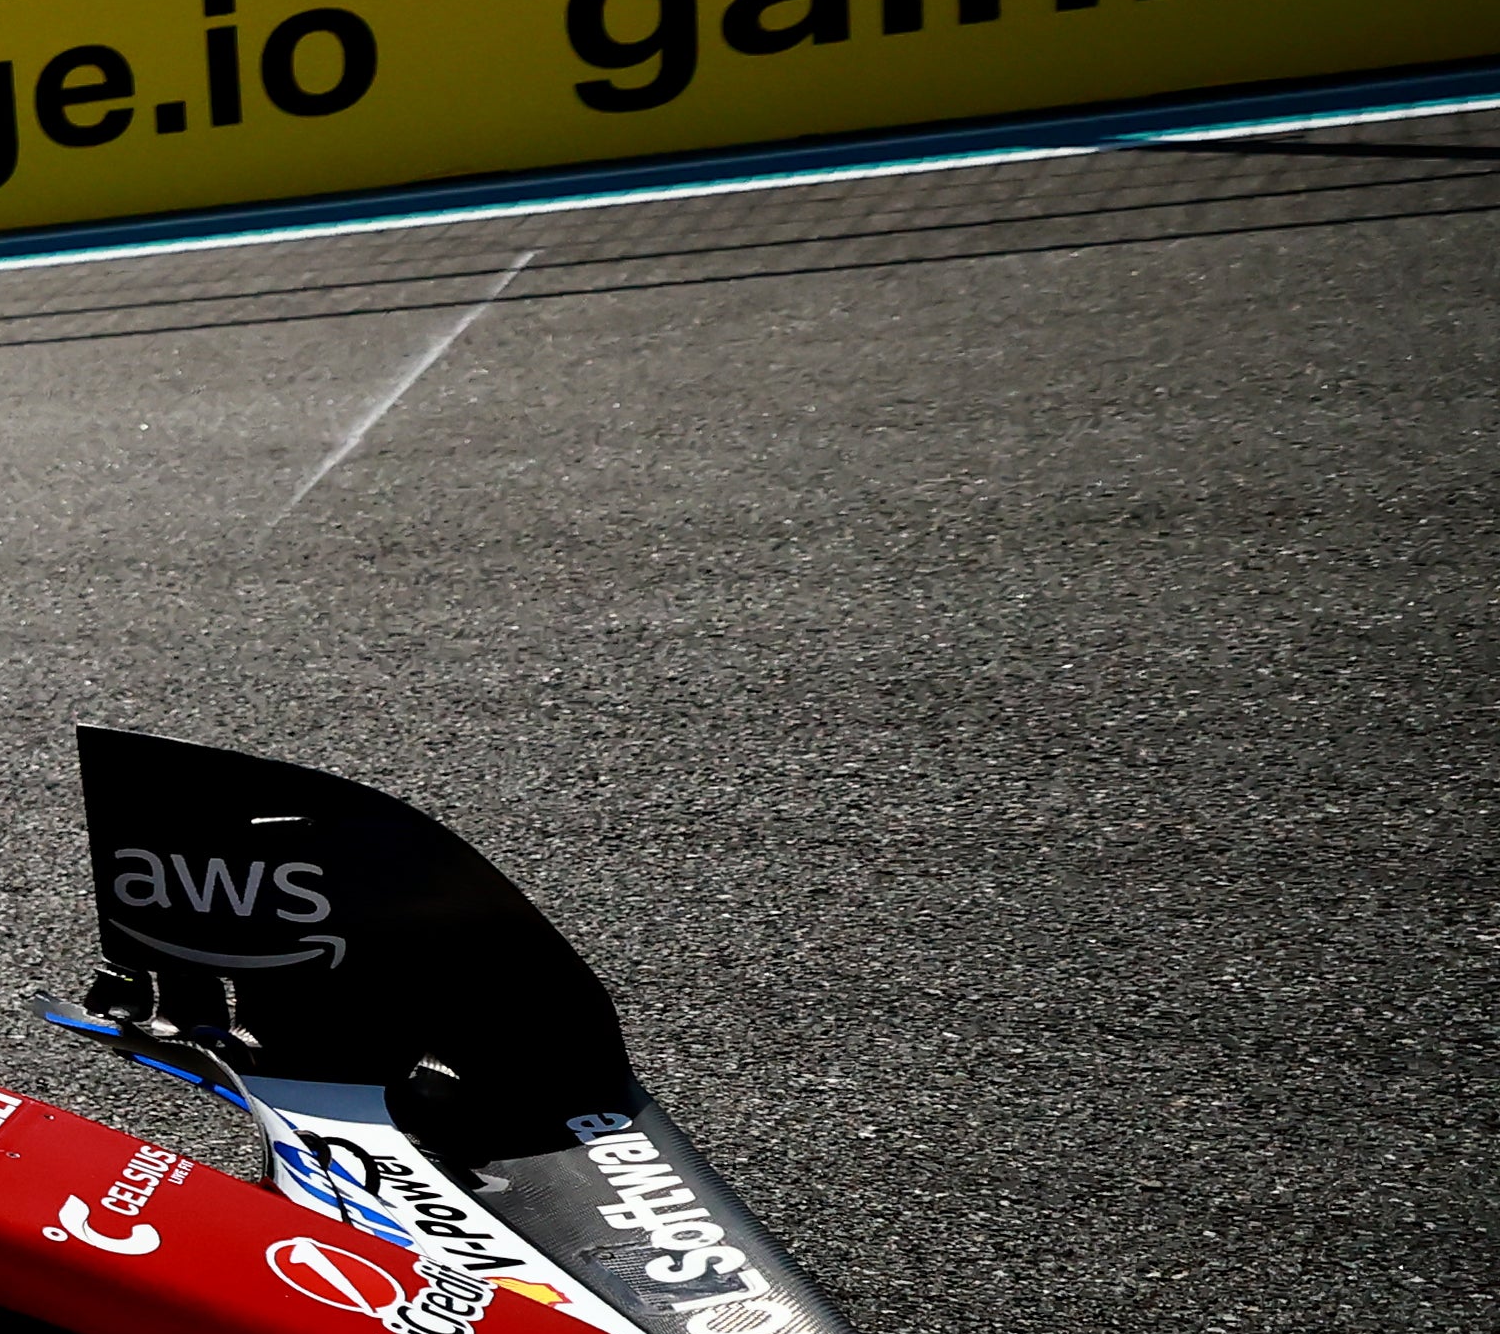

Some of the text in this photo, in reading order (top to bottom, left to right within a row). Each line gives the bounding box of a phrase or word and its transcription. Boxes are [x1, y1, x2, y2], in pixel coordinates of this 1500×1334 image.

[111, 846, 333, 925] aws
[100, 1145, 178, 1217] CELSIUS
[167, 1158, 195, 1186] LIVE FIT
[374, 1155, 527, 1271] V-Power
